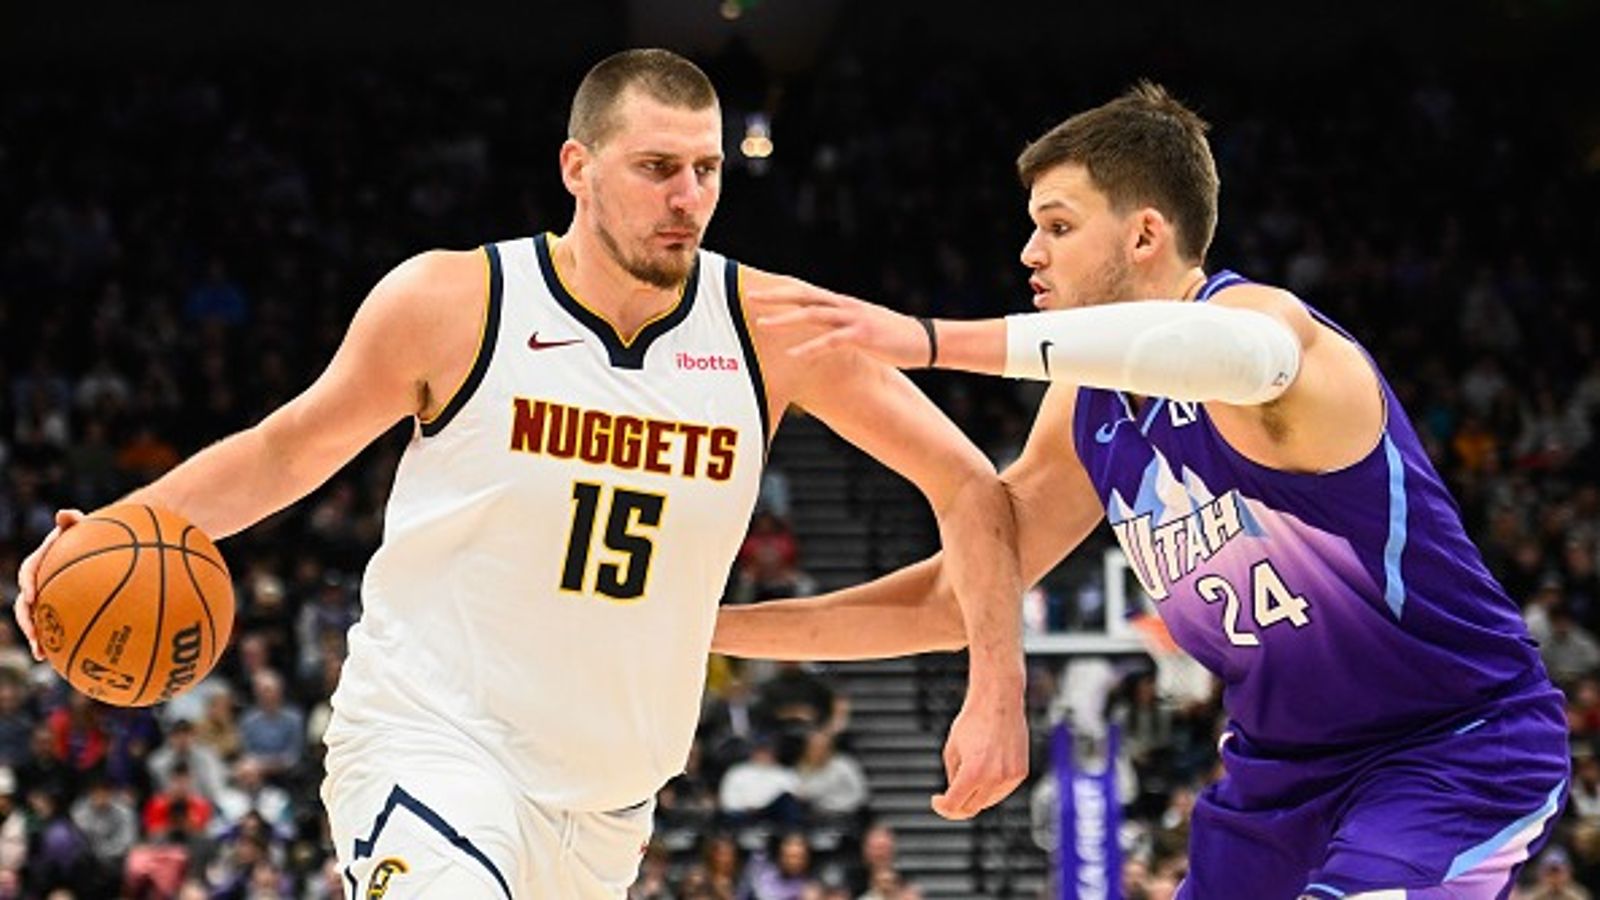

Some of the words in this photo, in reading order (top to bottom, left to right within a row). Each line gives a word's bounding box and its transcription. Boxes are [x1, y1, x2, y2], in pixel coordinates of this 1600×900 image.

[676, 353, 739, 371] ibotta
[509, 396, 740, 482] NUGGETS
[557, 480, 668, 605] 15
[1111, 488, 1245, 602] UTAH
[1195, 558, 1310, 646] 24
